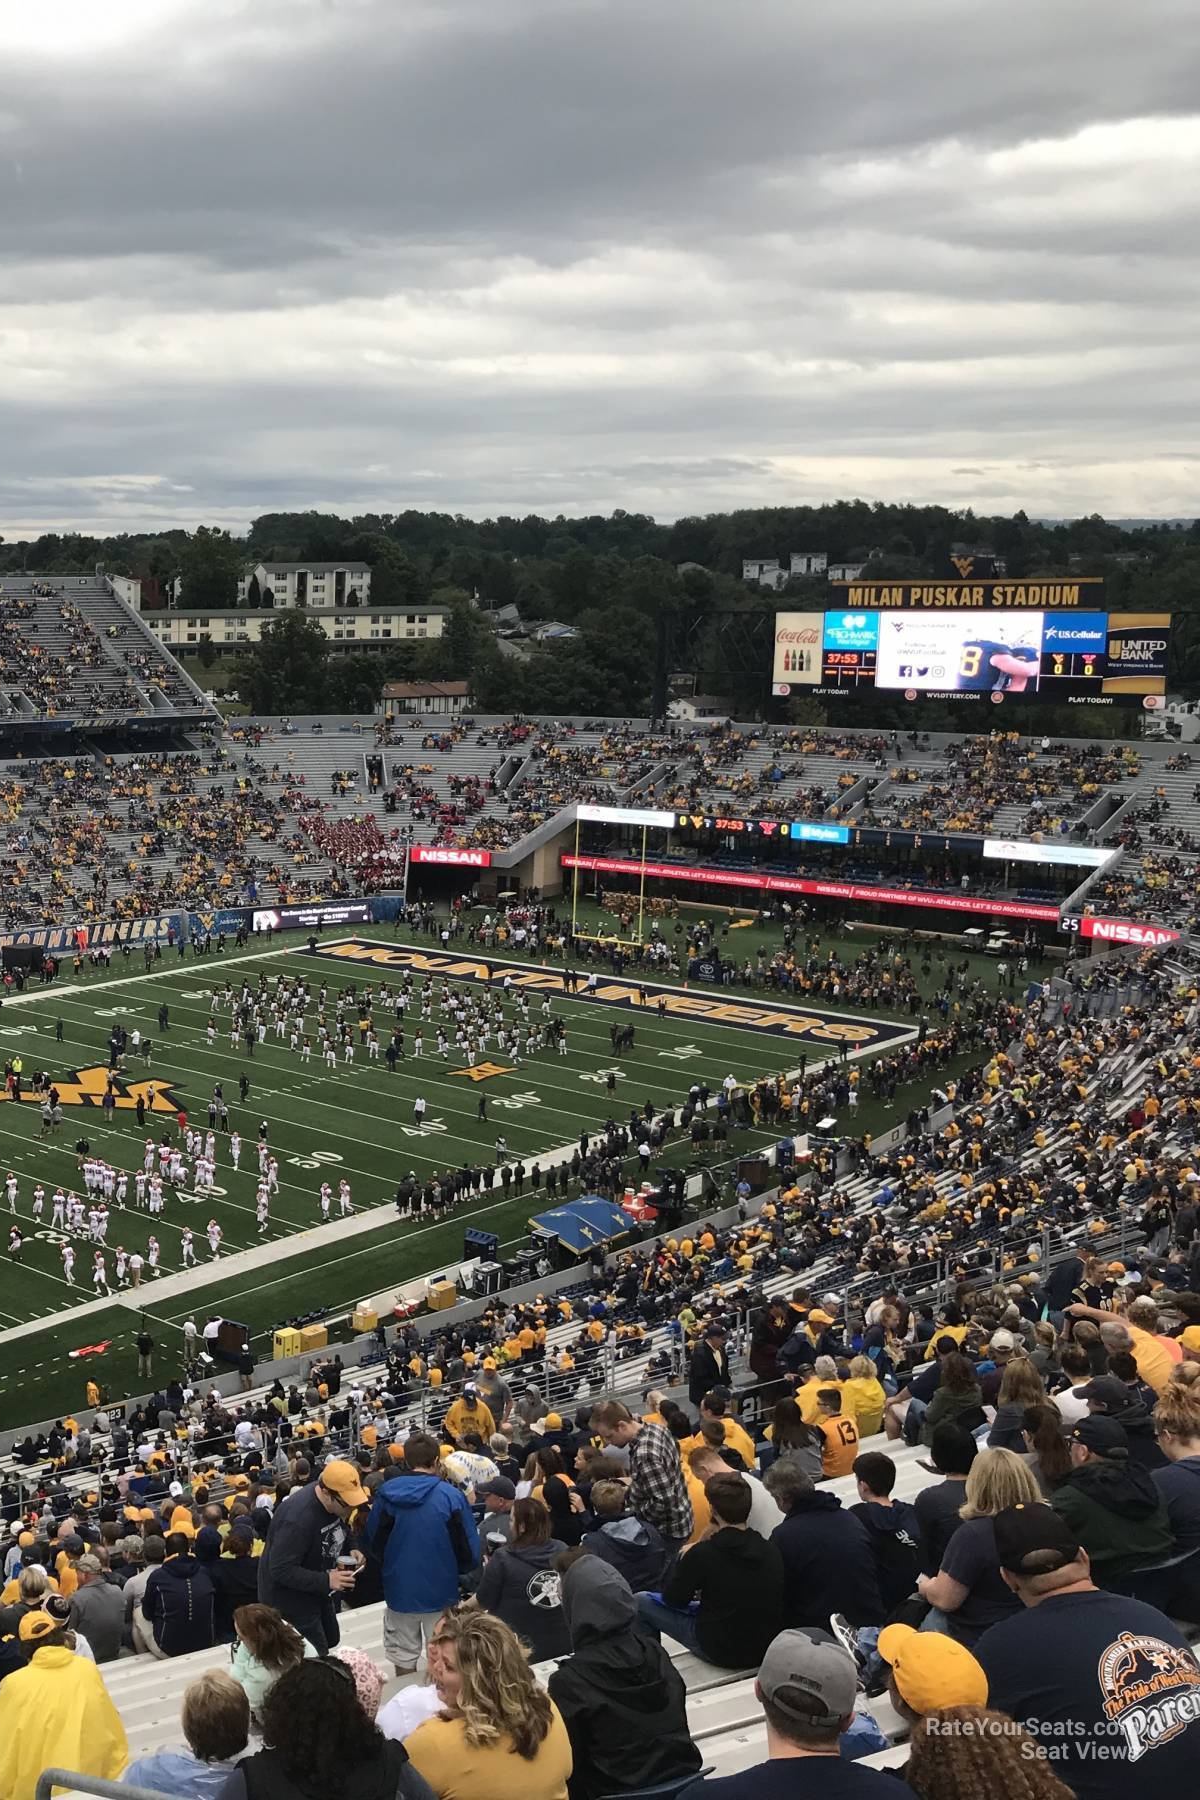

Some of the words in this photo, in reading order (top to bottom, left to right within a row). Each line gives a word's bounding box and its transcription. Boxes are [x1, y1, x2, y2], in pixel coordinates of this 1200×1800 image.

[847, 587, 903, 606] MILAN
[909, 586, 984, 606] PUSKAR
[991, 585, 1080, 605] STADIUM
[1121, 640, 1167, 651] UNITED
[827, 653, 858, 664] 37:53
[1121, 650, 1154, 660] BANK
[1054, 664, 1063, 675] 0
[1084, 664, 1093, 676] 0
[926, 692, 980, 700] WVLOTTERY.COM
[1068, 696, 1085, 704] PLAY
[1086, 697, 1113, 705] TODAY!
[679, 815, 687, 826] 0
[715, 819, 744, 830] 37:53
[780, 824, 789, 835] 0
[420, 850, 482, 865] NISSAN
[565, 859, 593, 867] NISSAN
[770, 881, 802, 890] NISSAN
[817, 886, 849, 895] NISSAN
[878, 892, 907, 901] PARTNER
[972, 902, 992, 910] LET'S
[1061, 918, 1079, 931] 25
[1092, 922, 1171, 944] NISSAN
[316, 942, 881, 1043] MOUNTAINEERS
[286, 1150, 344, 1169] 50
[836, 1420, 857, 1446] 13
[1127, 1639, 1170, 1653] MARCHING
[1105, 1695, 1124, 1717] The
[1123, 1681, 1150, 1705] Pride
[1149, 1676, 1161, 1692] of
[1160, 1671, 1183, 1689] West
